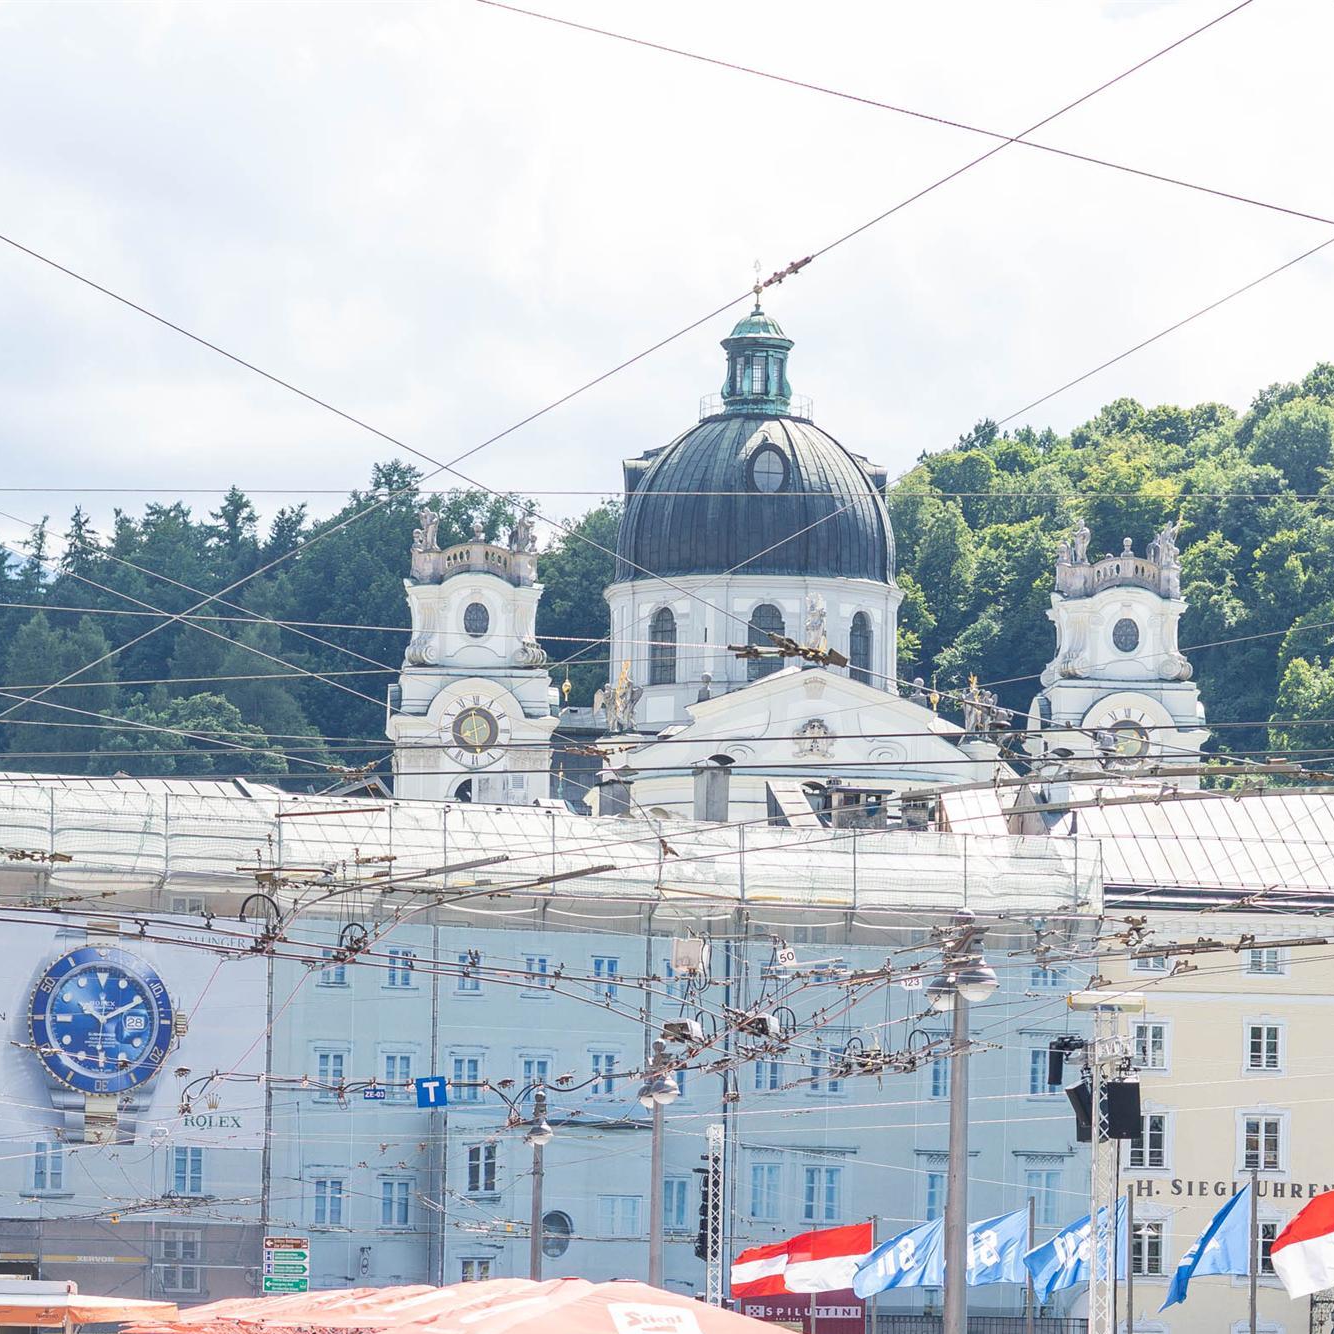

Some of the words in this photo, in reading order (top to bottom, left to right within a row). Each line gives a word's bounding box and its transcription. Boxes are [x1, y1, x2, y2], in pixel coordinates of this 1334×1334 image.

[779, 951, 795, 964] 50
[127, 1017, 143, 1028] 28
[422, 1081, 440, 1103] T
[183, 1114, 242, 1128] ROLEX
[1136, 1179, 1161, 1197] H.
